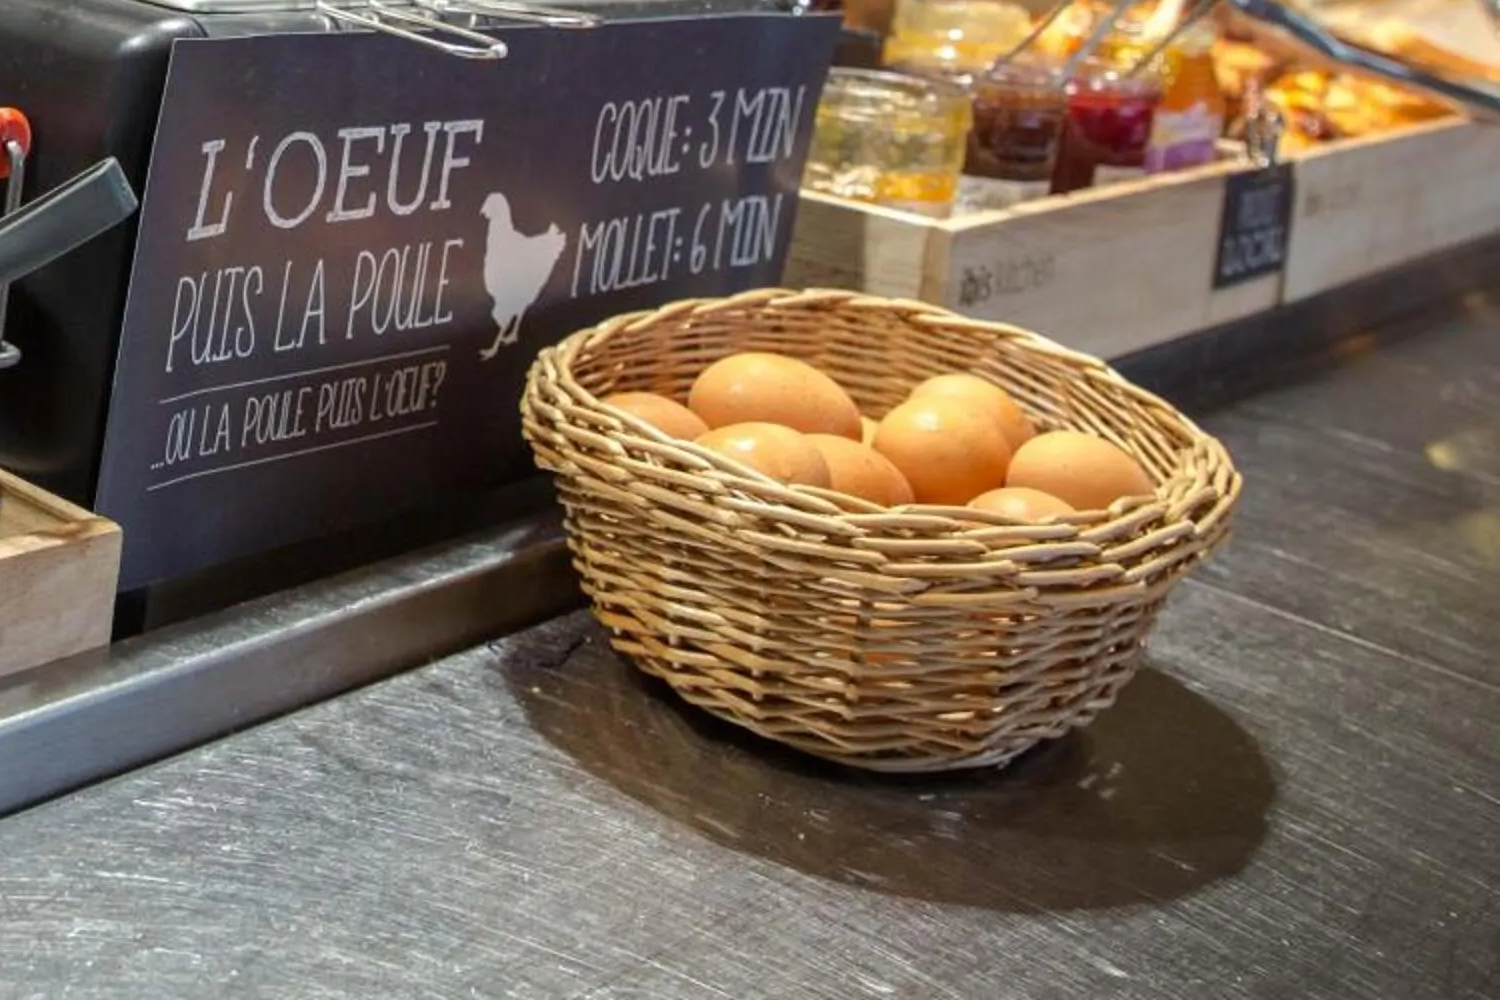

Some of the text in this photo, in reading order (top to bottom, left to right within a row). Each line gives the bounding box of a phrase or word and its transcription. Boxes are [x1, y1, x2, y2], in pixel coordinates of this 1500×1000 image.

[700, 89, 726, 169] 3
[726, 83, 807, 166] MIN
[186, 118, 485, 242] L'OEUF
[712, 192, 784, 271] MIN
[165, 238, 465, 374] PUIS LA POULE
[199, 403, 231, 457] LA
[241, 386, 313, 448] POULE
[315, 376, 367, 433] PUIS
